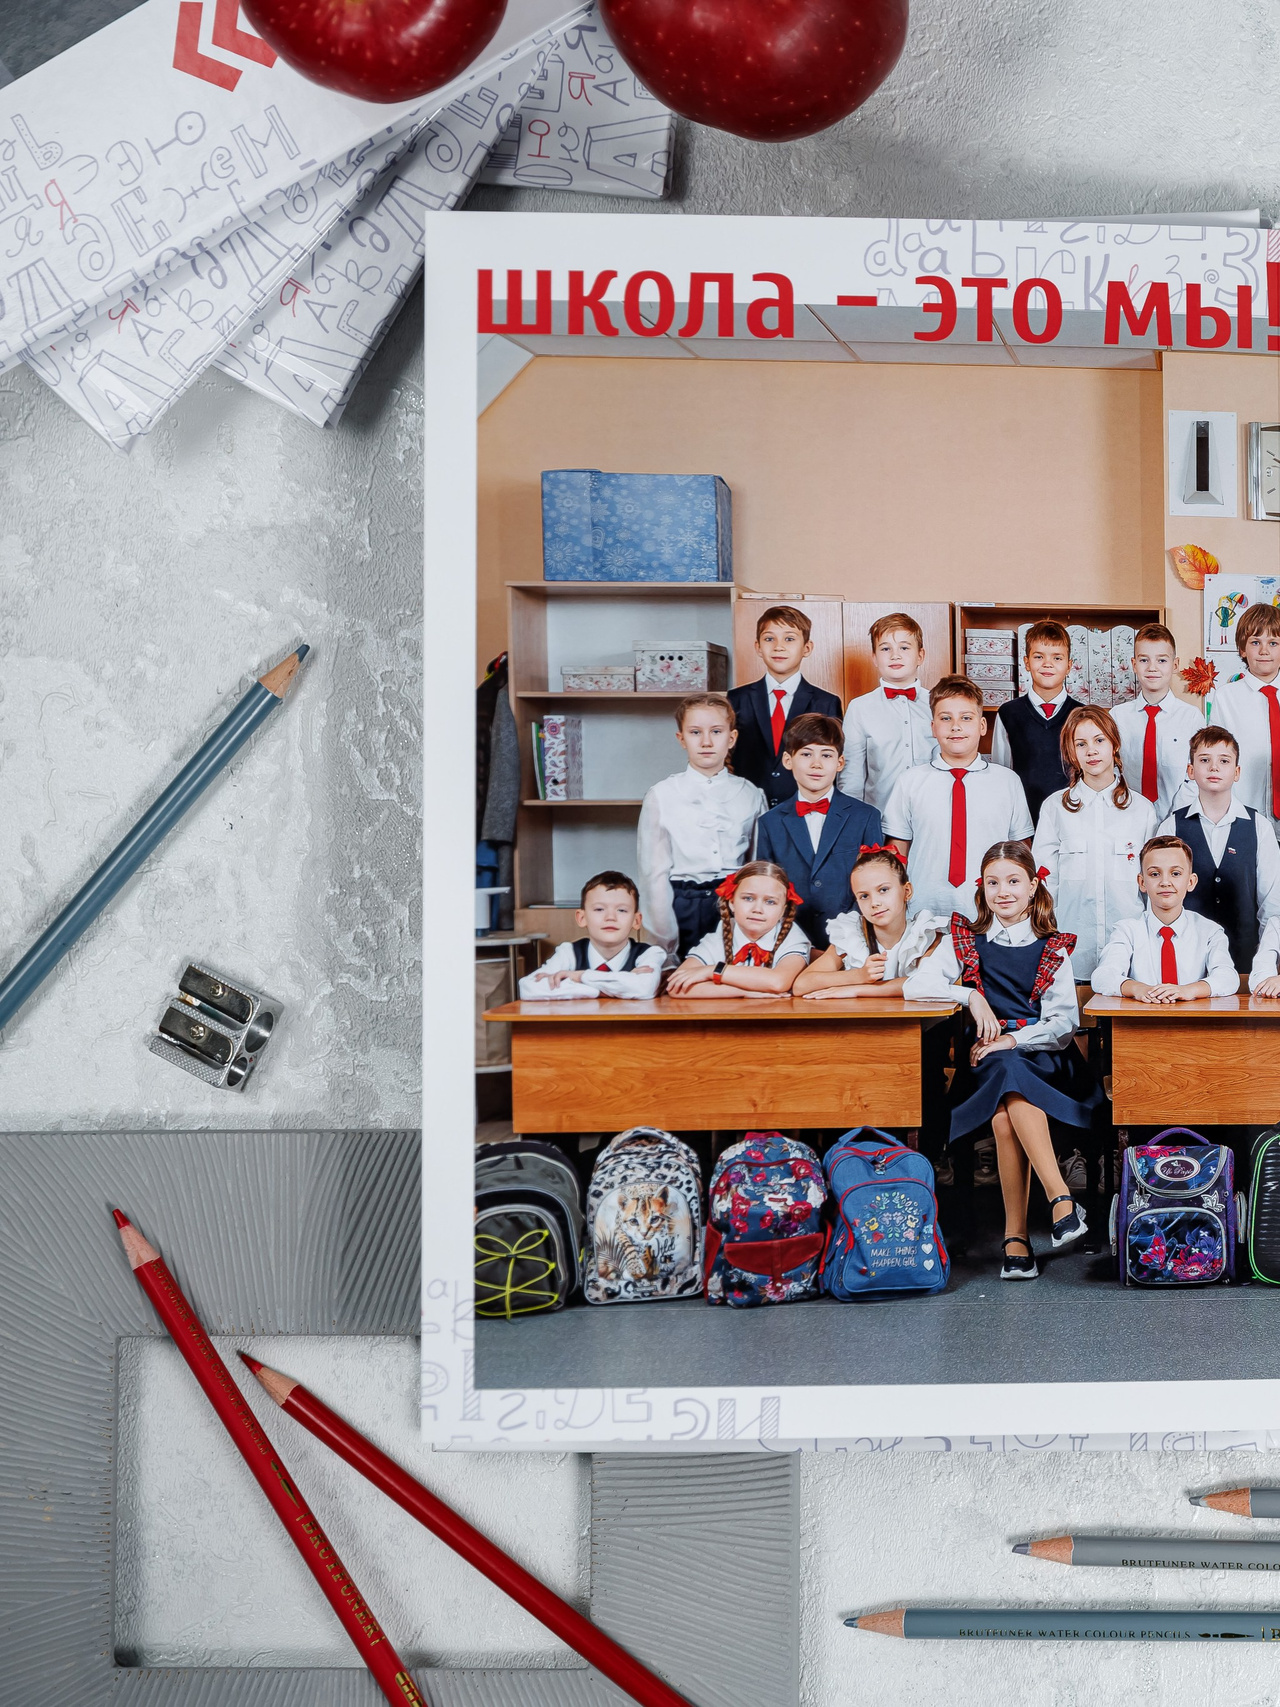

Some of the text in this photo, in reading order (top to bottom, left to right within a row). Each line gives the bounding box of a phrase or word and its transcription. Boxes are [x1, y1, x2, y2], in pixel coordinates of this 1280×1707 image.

[476, 268, 796, 339] школа
[913, 275, 1063, 344] это
[871, 1248, 891, 1257] MAKE
[150, 1260, 191, 1321] RUTFUNER
[187, 1322, 215, 1360] WATER
[211, 1363, 242, 1410] COLOUR
[1121, 1559, 1196, 1568] BRUTFUNER
[1201, 1561, 1243, 1570] WATER
[959, 1628, 1191, 1639] BRUTFUNER WATER COLOUR PENCILS
